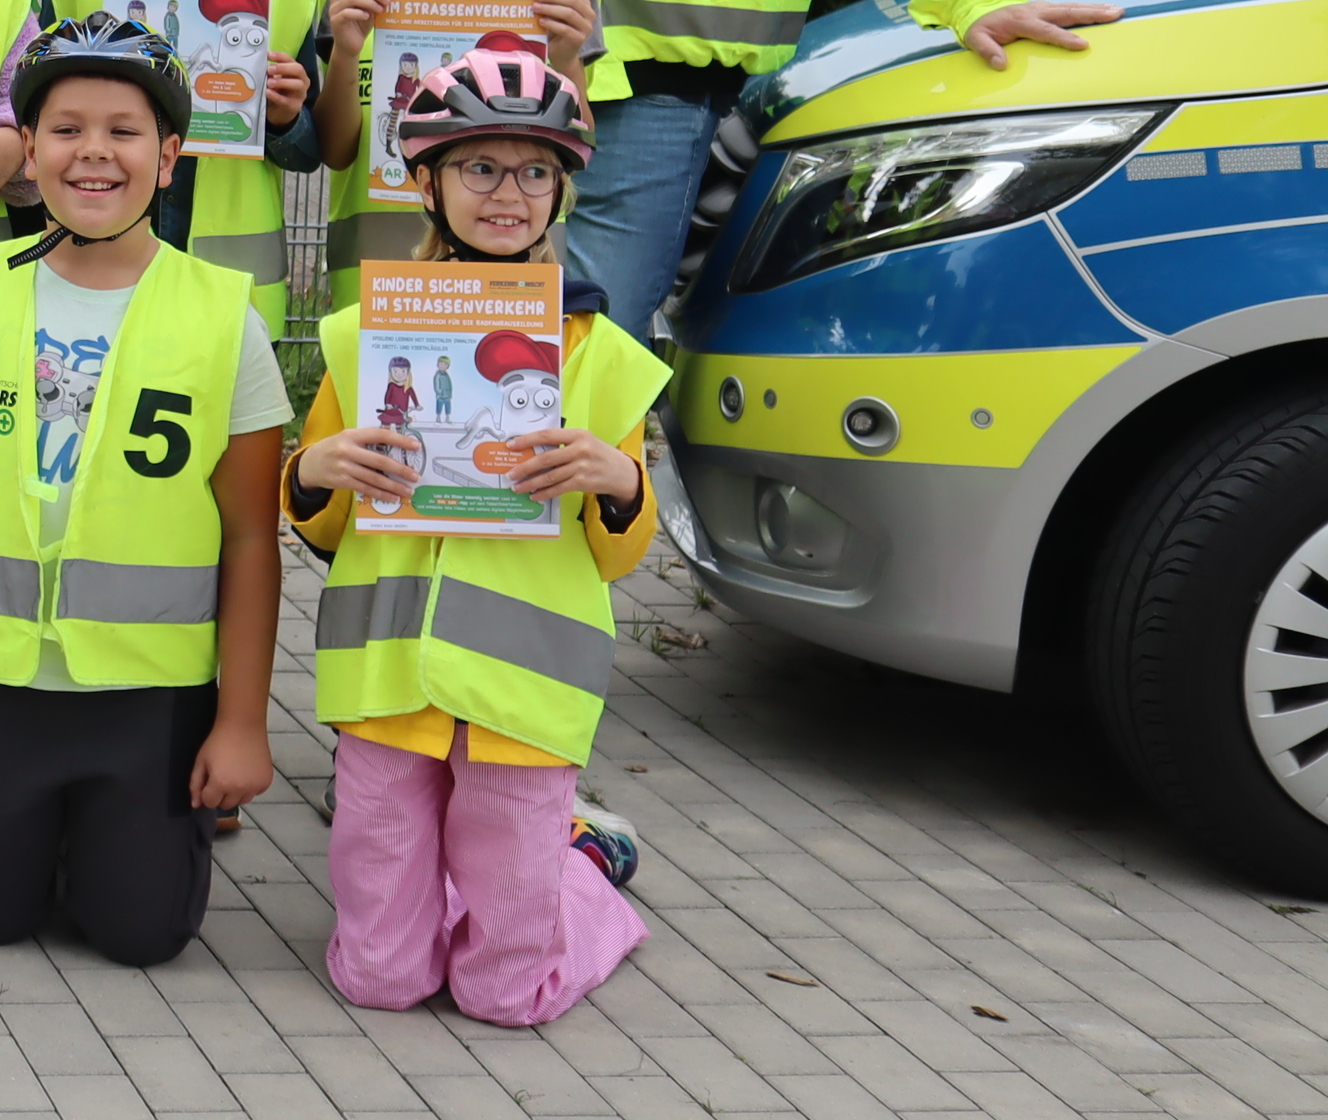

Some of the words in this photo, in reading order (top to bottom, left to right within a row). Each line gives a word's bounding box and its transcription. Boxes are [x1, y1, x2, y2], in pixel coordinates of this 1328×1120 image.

[404, 1, 534, 19] STRASSENVERKEHR
[384, 168, 402, 179] AR
[372, 276, 424, 293] KINDER
[428, 278, 482, 295] SICHER
[372, 297, 388, 311] IM
[393, 297, 546, 316] STRASSENVERKEHR
[403, 317, 447, 325] ARBEITSBUCH
[475, 319, 545, 328] RADFAHRAUSBILDUNG
[123, 387, 193, 479] 5
